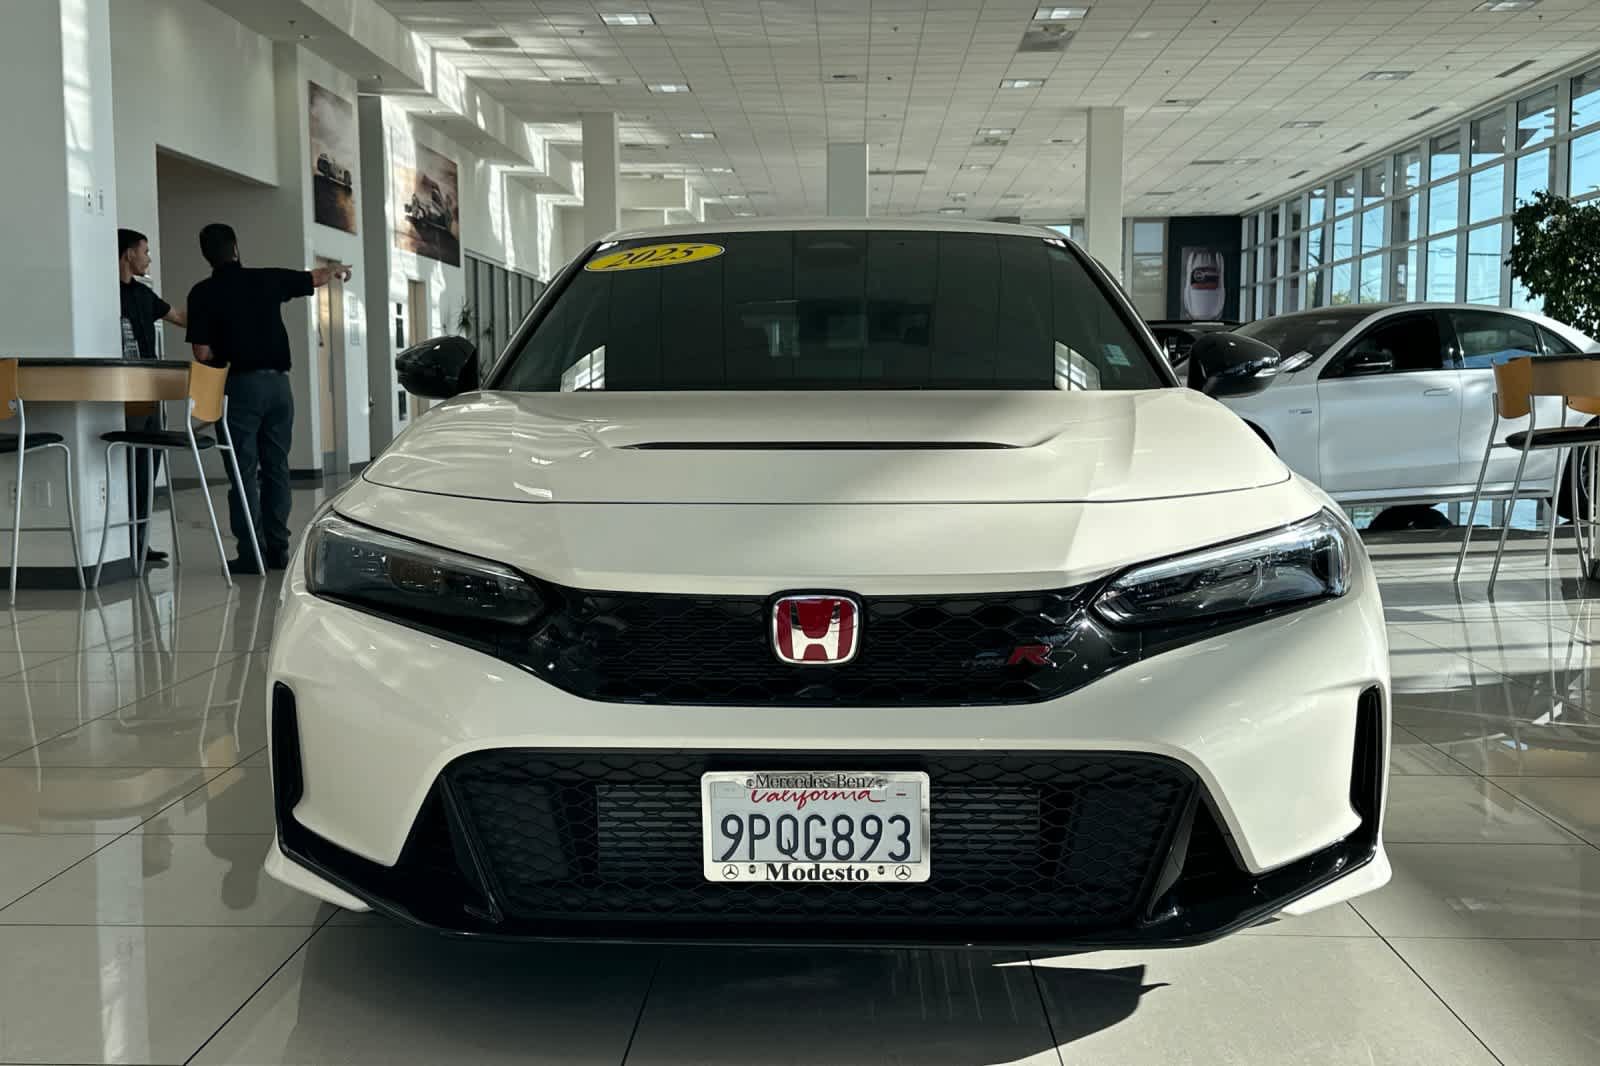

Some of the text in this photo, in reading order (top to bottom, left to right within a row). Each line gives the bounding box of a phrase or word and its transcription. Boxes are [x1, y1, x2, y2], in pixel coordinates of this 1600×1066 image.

[604, 246, 704, 269] 2025
[755, 774, 875, 789] Mercedes-Benz
[750, 789, 886, 810] California
[720, 814, 912, 861] 9PQG893
[765, 863, 869, 881] Modesto
